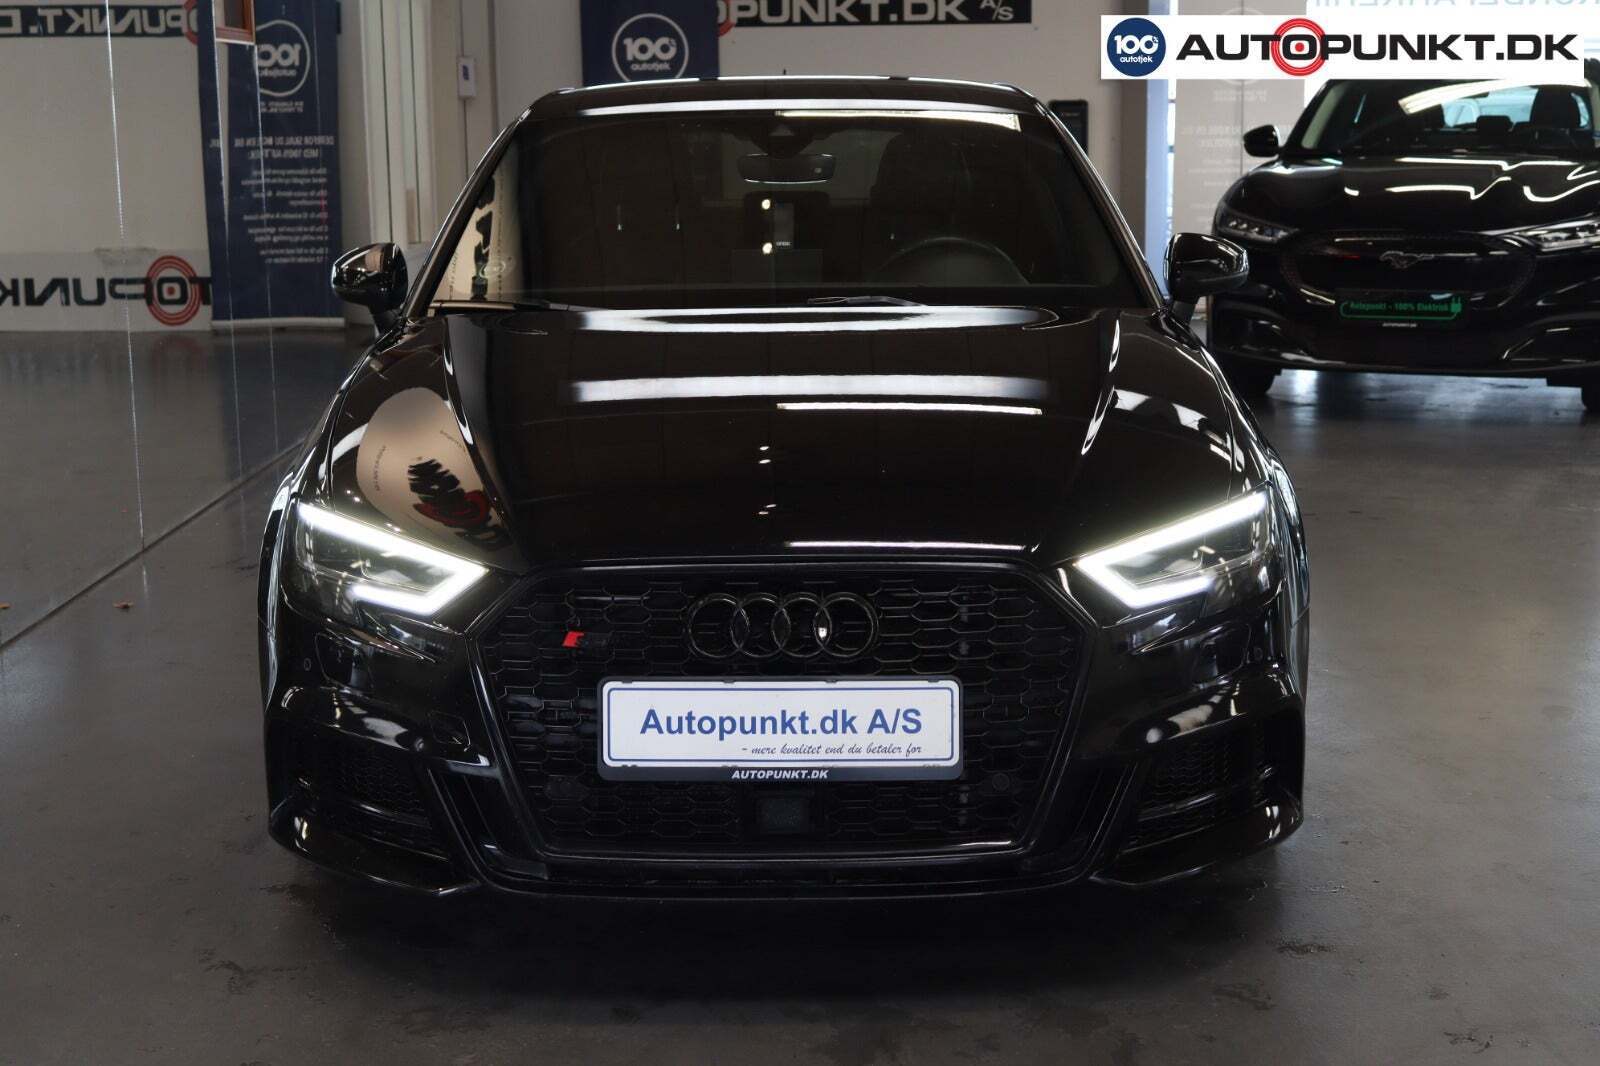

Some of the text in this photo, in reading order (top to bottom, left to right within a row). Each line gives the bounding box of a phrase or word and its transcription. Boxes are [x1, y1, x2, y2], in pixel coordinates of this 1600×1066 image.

[640, 708, 922, 741] Autopunkt.dk A/S
[752, 746, 776, 755] mere
[780, 743, 821, 755] kvalitet
[825, 744, 845, 754] end
[848, 744, 862, 754] du
[866, 742, 902, 754] betaler
[905, 743, 922, 757] for
[732, 769, 829, 780] AUTOPUNKT.DK
